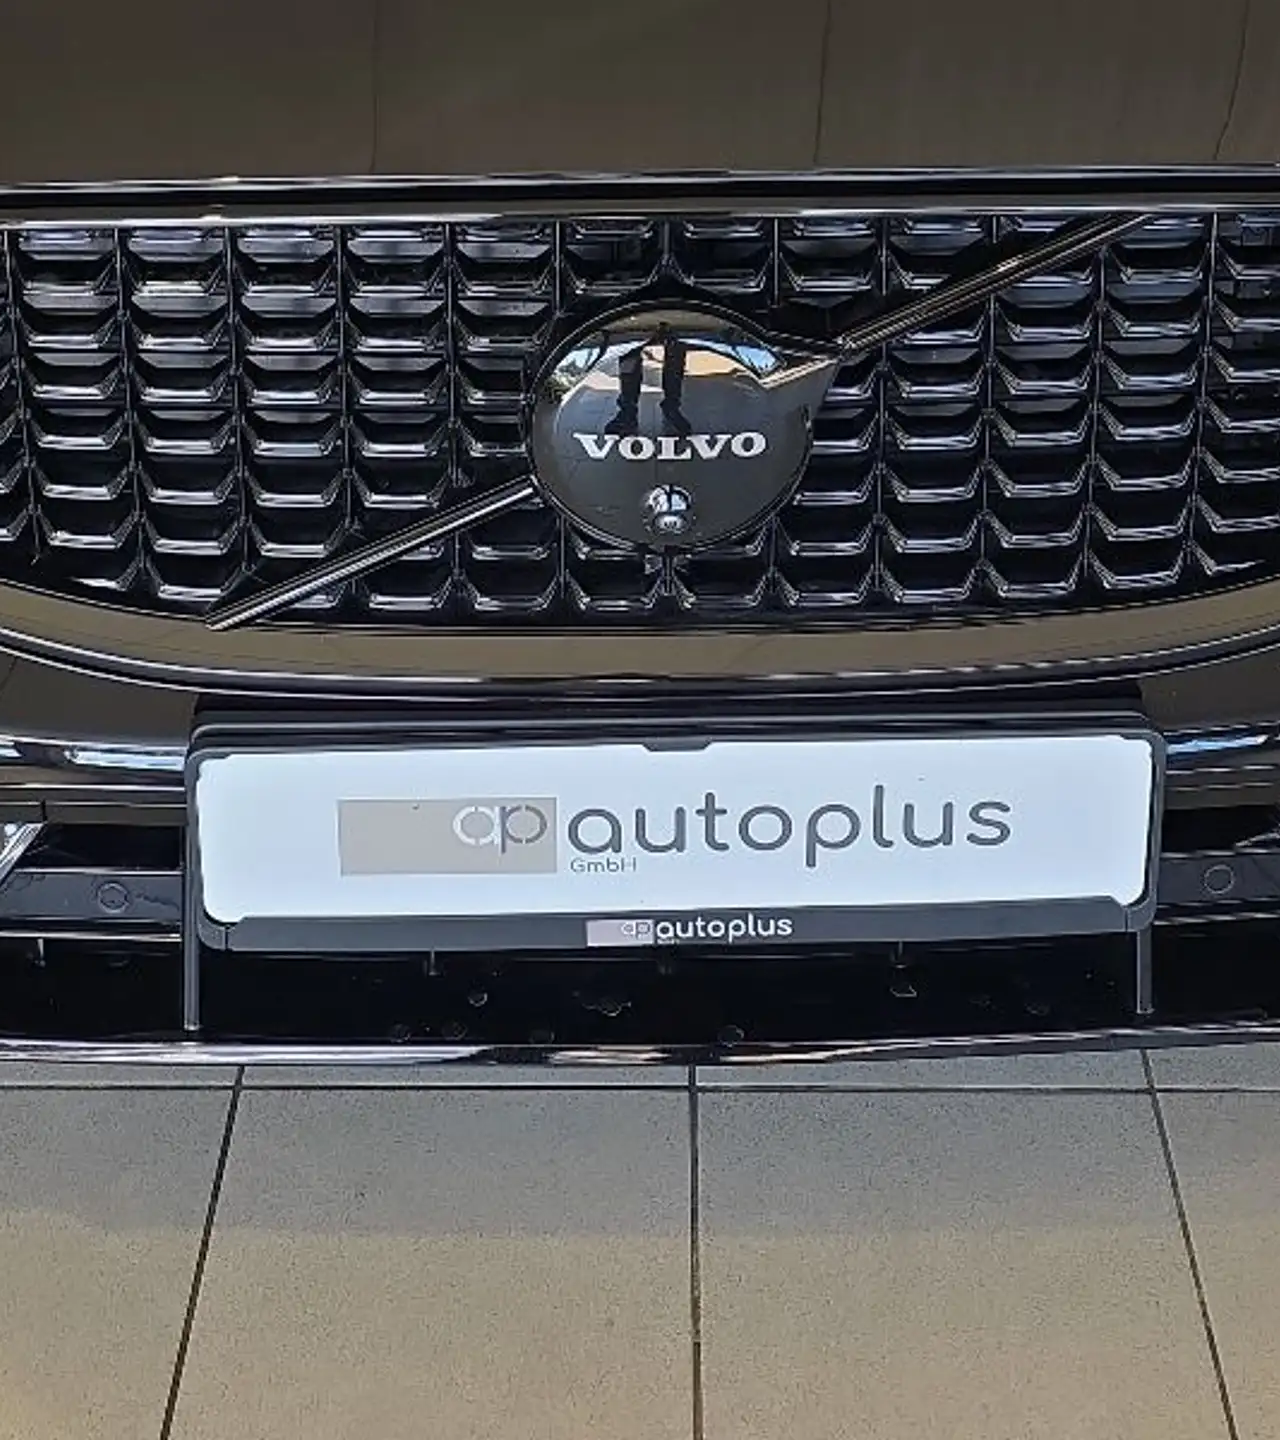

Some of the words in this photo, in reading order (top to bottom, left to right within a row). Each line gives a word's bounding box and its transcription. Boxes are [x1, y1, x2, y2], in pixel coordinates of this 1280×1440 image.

[573, 431, 767, 460] VOLVO
[567, 784, 1012, 868] autoplus
[570, 857, 637, 873] GmbH
[656, 912, 793, 943] autoplus
